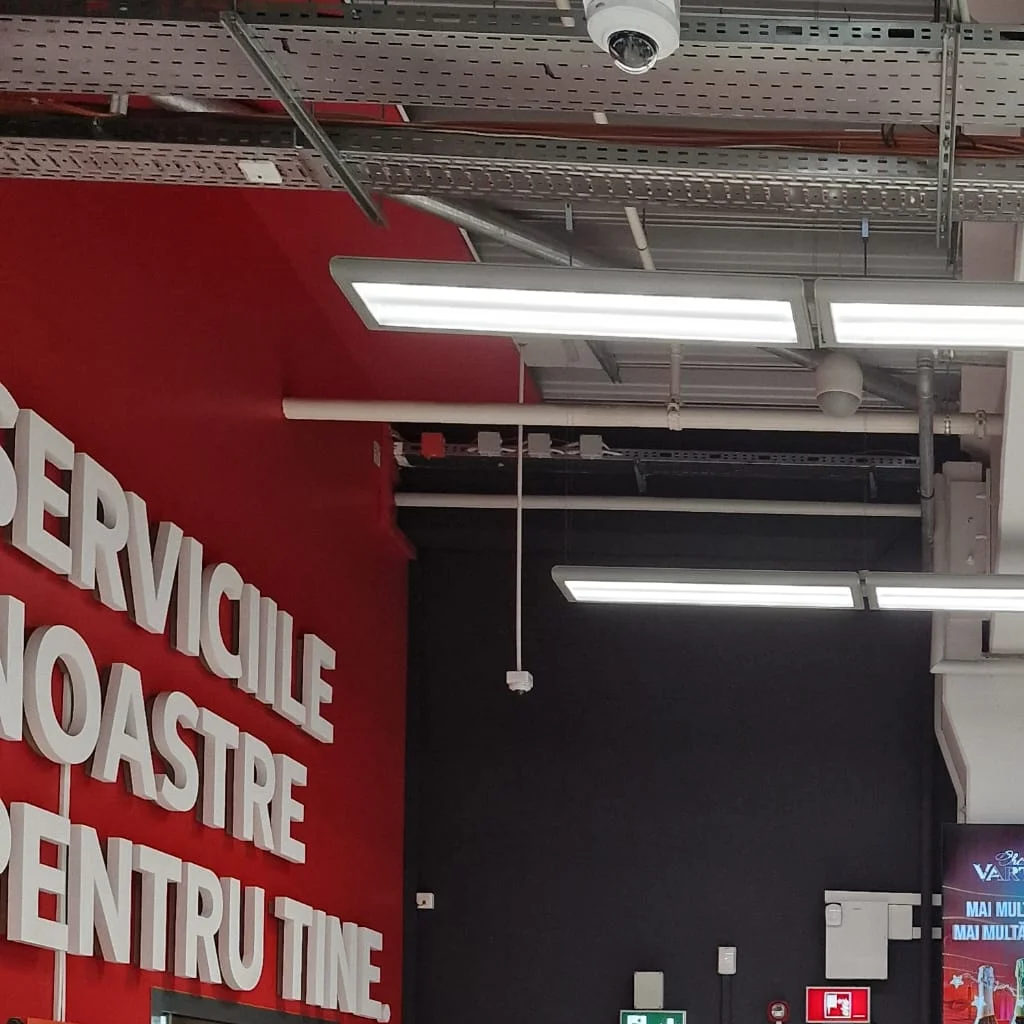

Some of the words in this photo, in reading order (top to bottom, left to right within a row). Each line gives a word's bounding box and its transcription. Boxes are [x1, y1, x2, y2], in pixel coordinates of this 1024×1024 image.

[0, 798, 264, 991] ENTRU
[275, 896, 390, 1023] TINE.
[966, 901, 991, 918] MAI
[952, 924, 980, 941] MAI
